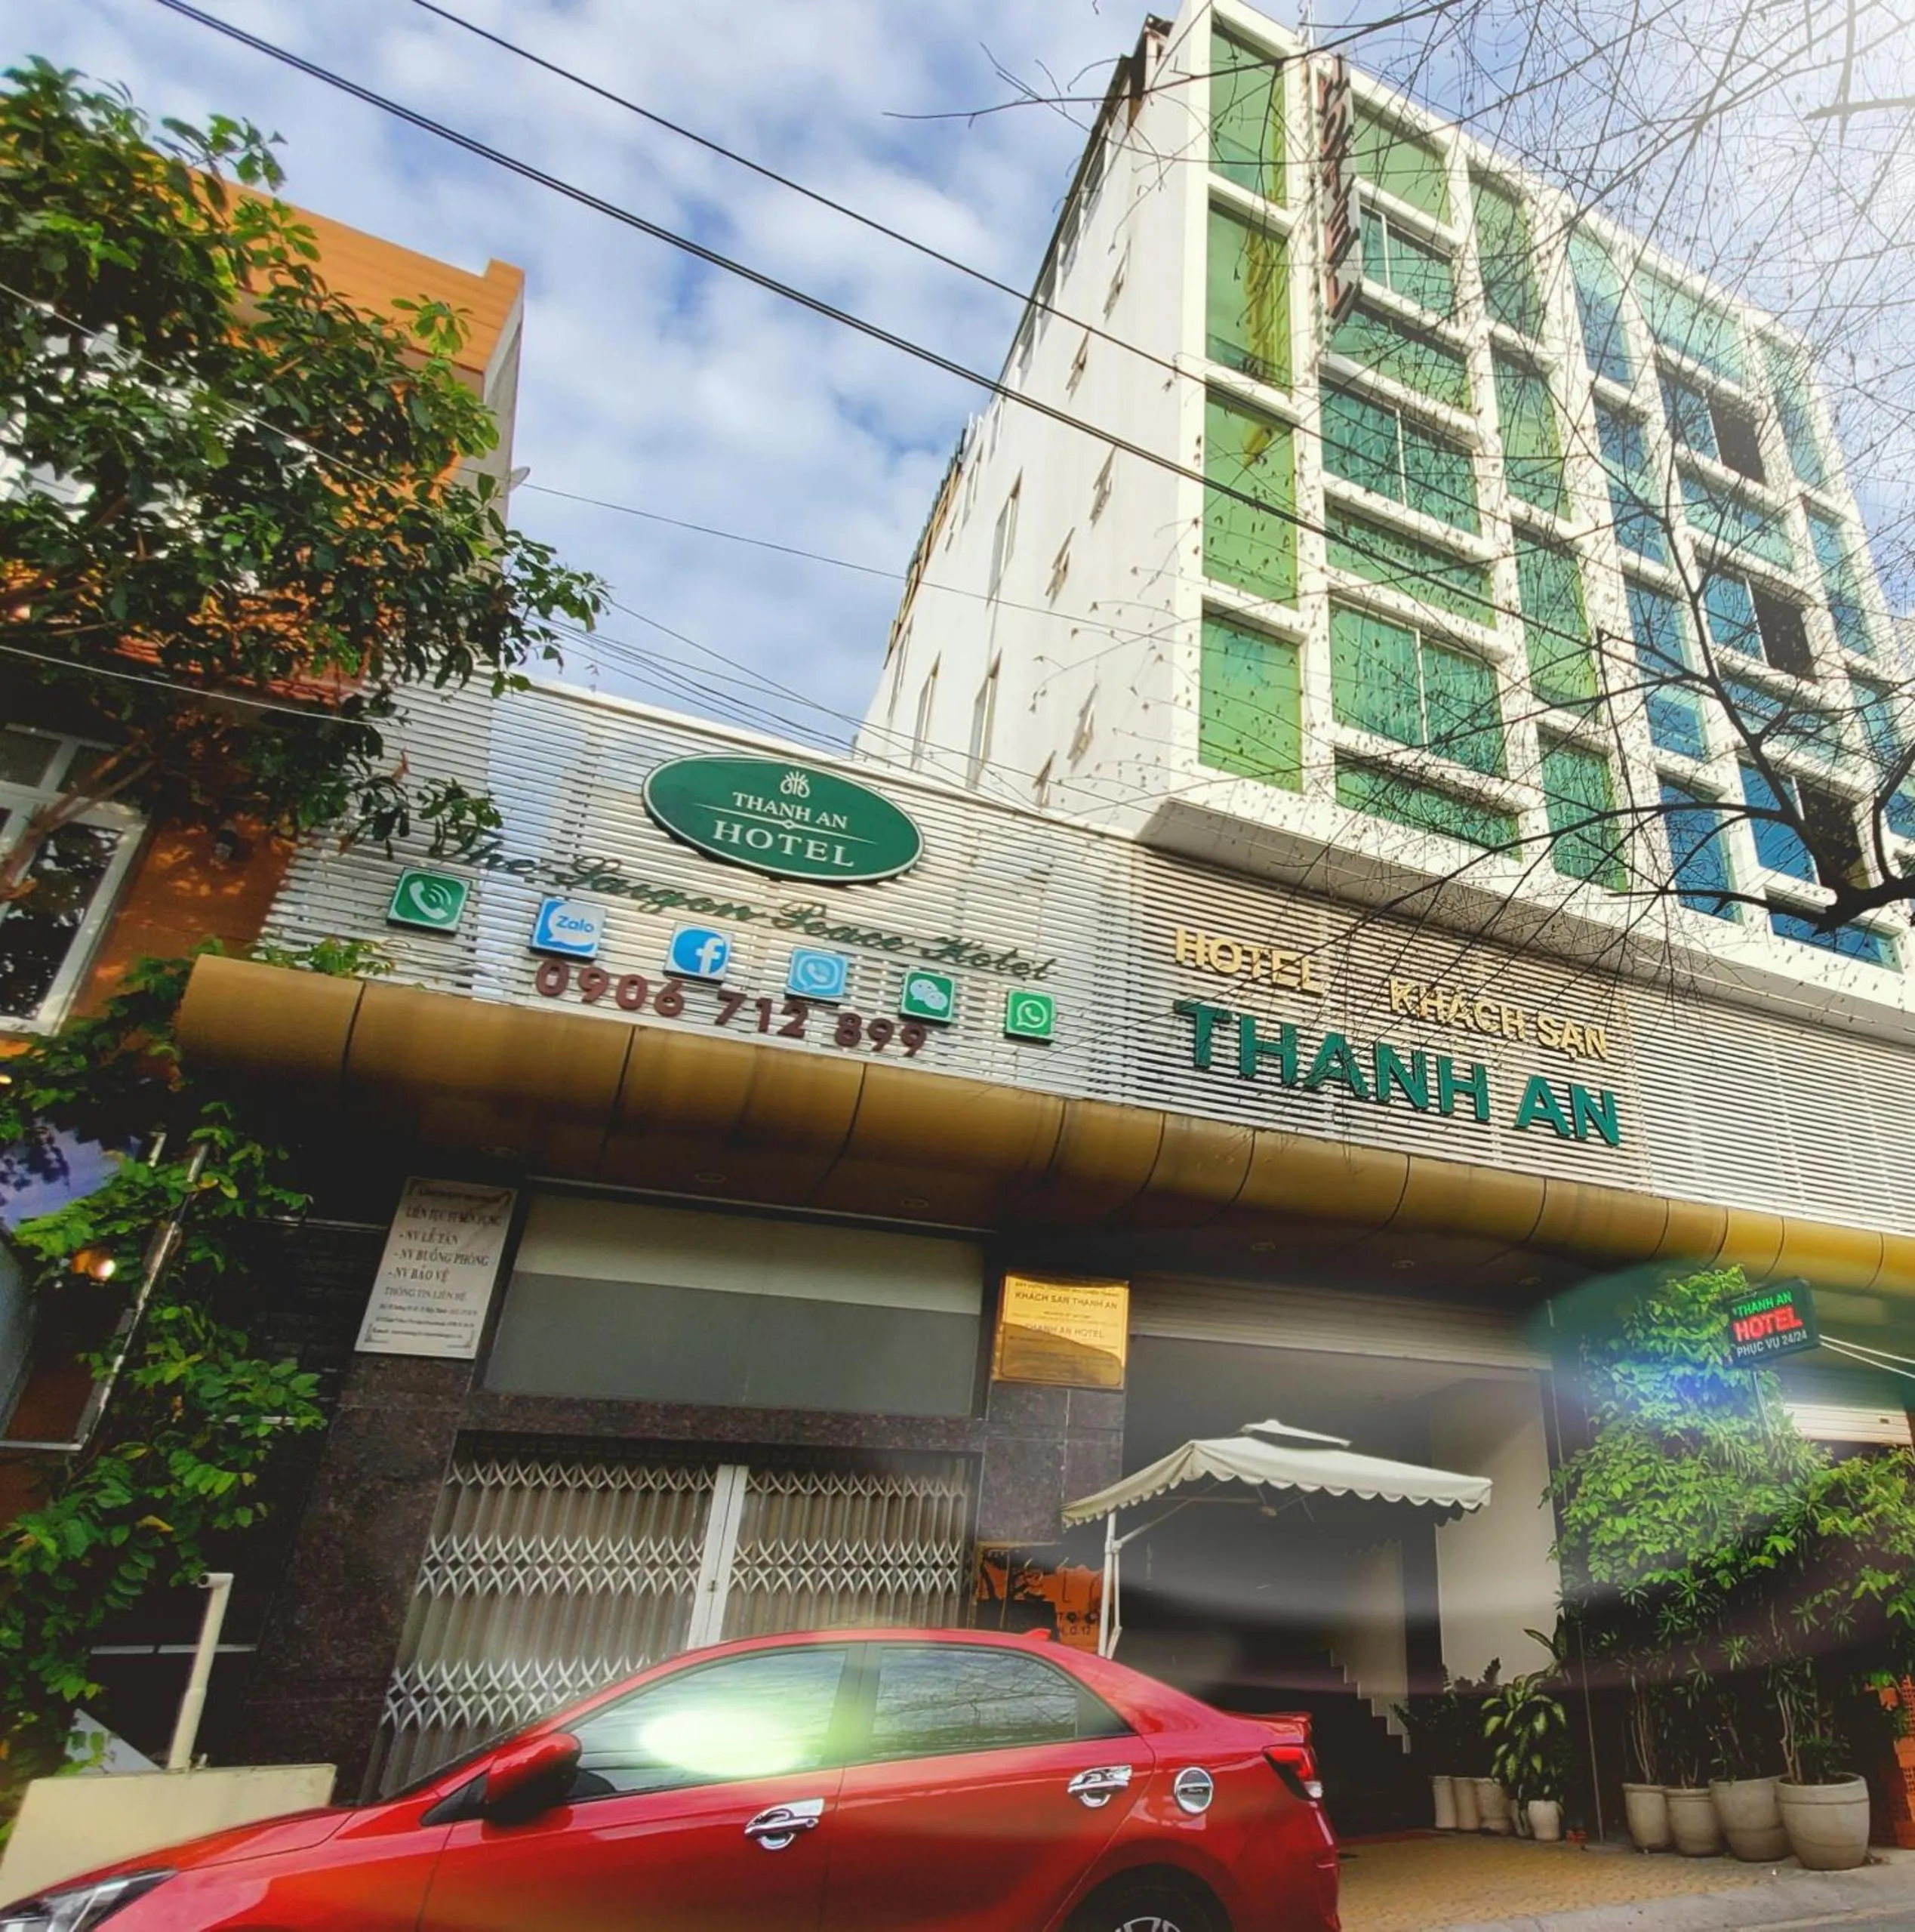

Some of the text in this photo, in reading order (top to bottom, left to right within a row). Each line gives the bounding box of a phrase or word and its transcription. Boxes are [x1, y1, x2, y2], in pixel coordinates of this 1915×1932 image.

[732, 791, 848, 830] THANH AN
[713, 819, 854, 867] HOTEL
[556, 914, 595, 935] Zalo
[771, 901, 915, 951] Peace
[921, 935, 1058, 981] Hotel
[1175, 927, 1328, 997] HOTEL
[534, 958, 928, 1058] 0906 712 899
[1173, 999, 1621, 1147] THANH AN
[1104, 1301, 1117, 1310] AN
[1732, 1305, 1803, 1342] HOTEL
[1736, 1290, 1793, 1318] THANH AN
[1781, 1330, 1807, 1345] 24/24
